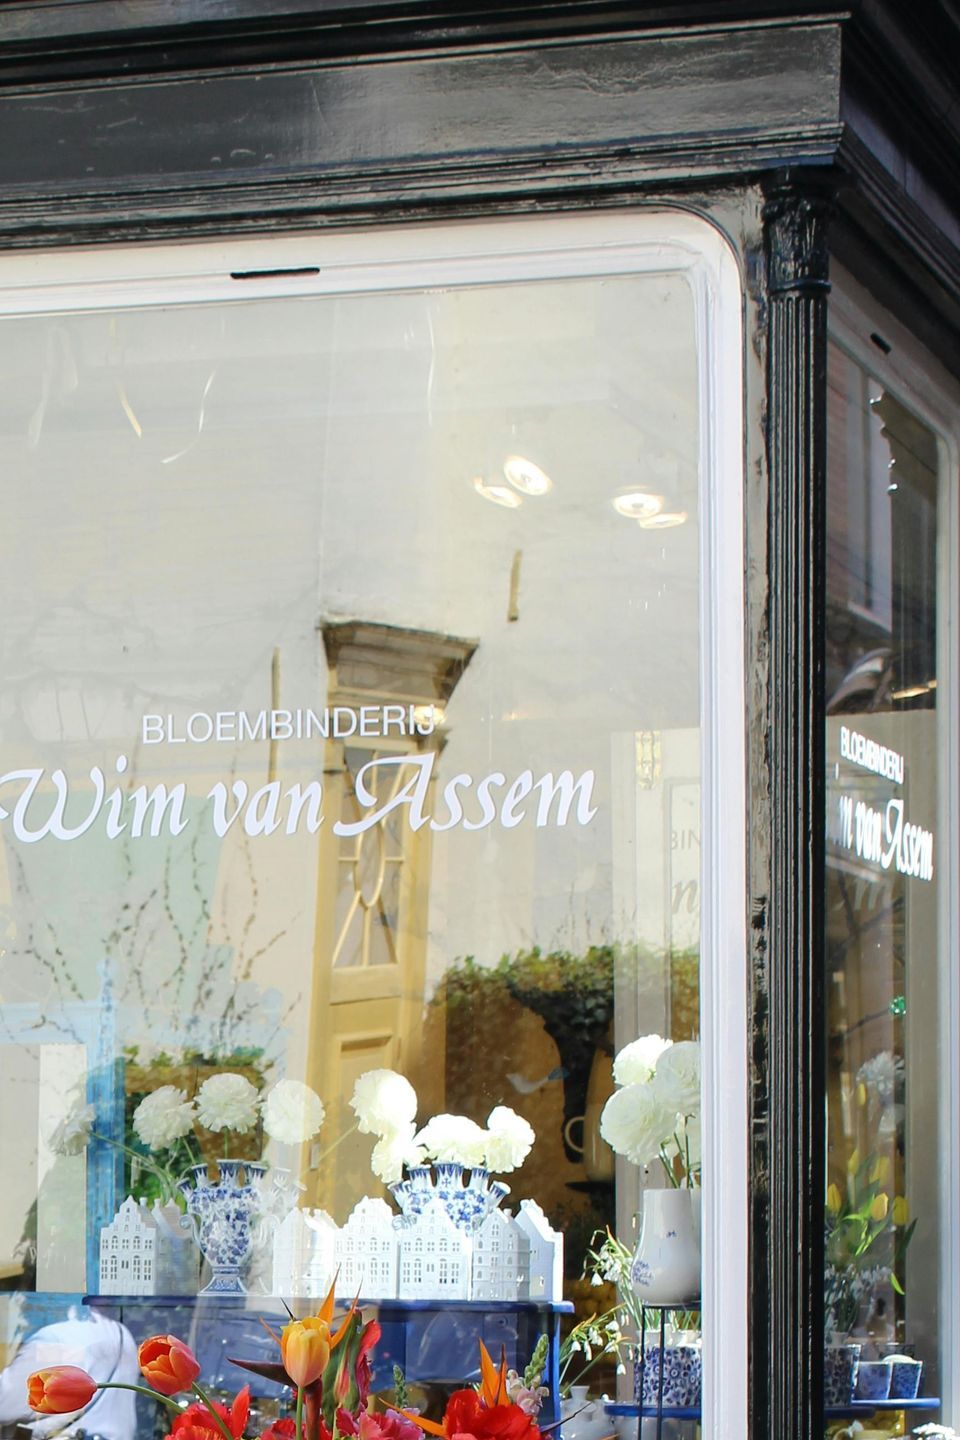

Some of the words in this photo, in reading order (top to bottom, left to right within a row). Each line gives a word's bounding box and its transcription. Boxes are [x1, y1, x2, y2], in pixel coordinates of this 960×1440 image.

[141, 703, 436, 745] BLOEMBINDERIJ
[841, 725, 904, 785] BLOEMBINDERIJ
[206, 779, 326, 839] van
[332, 751, 599, 837] Assem
[855, 801, 882, 863] van
[881, 798, 934, 881] Assem
